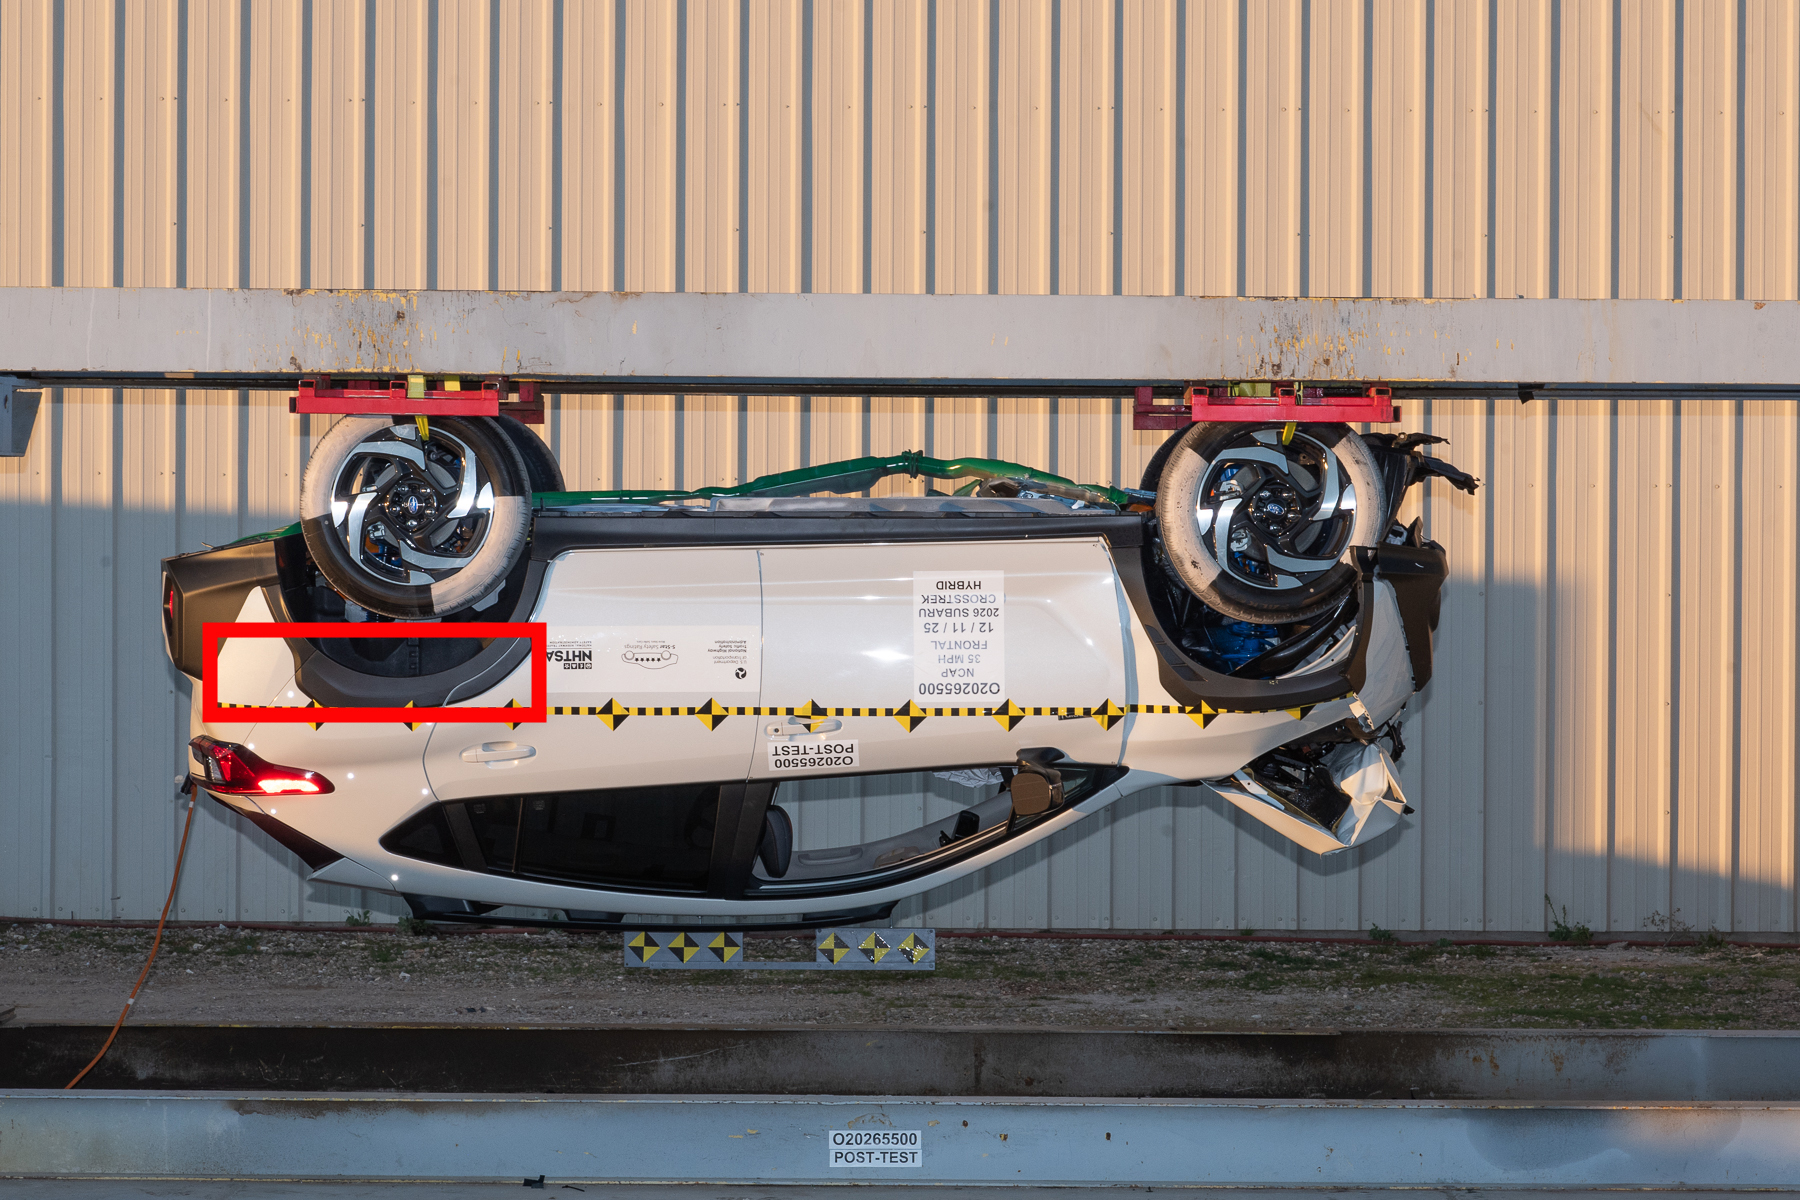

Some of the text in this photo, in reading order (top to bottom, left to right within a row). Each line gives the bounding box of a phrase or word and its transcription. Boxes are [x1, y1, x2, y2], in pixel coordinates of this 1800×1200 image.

[936, 581, 981, 590] HYBRID
[921, 594, 996, 604] CROSSTREK
[919, 608, 999, 617] 2026 SUBARU
[924, 623, 939, 633] 25
[952, 622, 966, 633] 11
[979, 622, 994, 633] 12
[931, 641, 987, 649] FRONTAL
[546, 650, 592, 662] NHTSA
[938, 654, 980, 663] 35 MPH
[941, 668, 974, 677] NCAP
[919, 682, 1000, 695] O20265500
[772, 744, 854, 756] POST-TEST
[774, 756, 853, 768] O20265500
[833, 1133, 917, 1145] O20265500
[835, 1152, 918, 1163] POST-TEST
